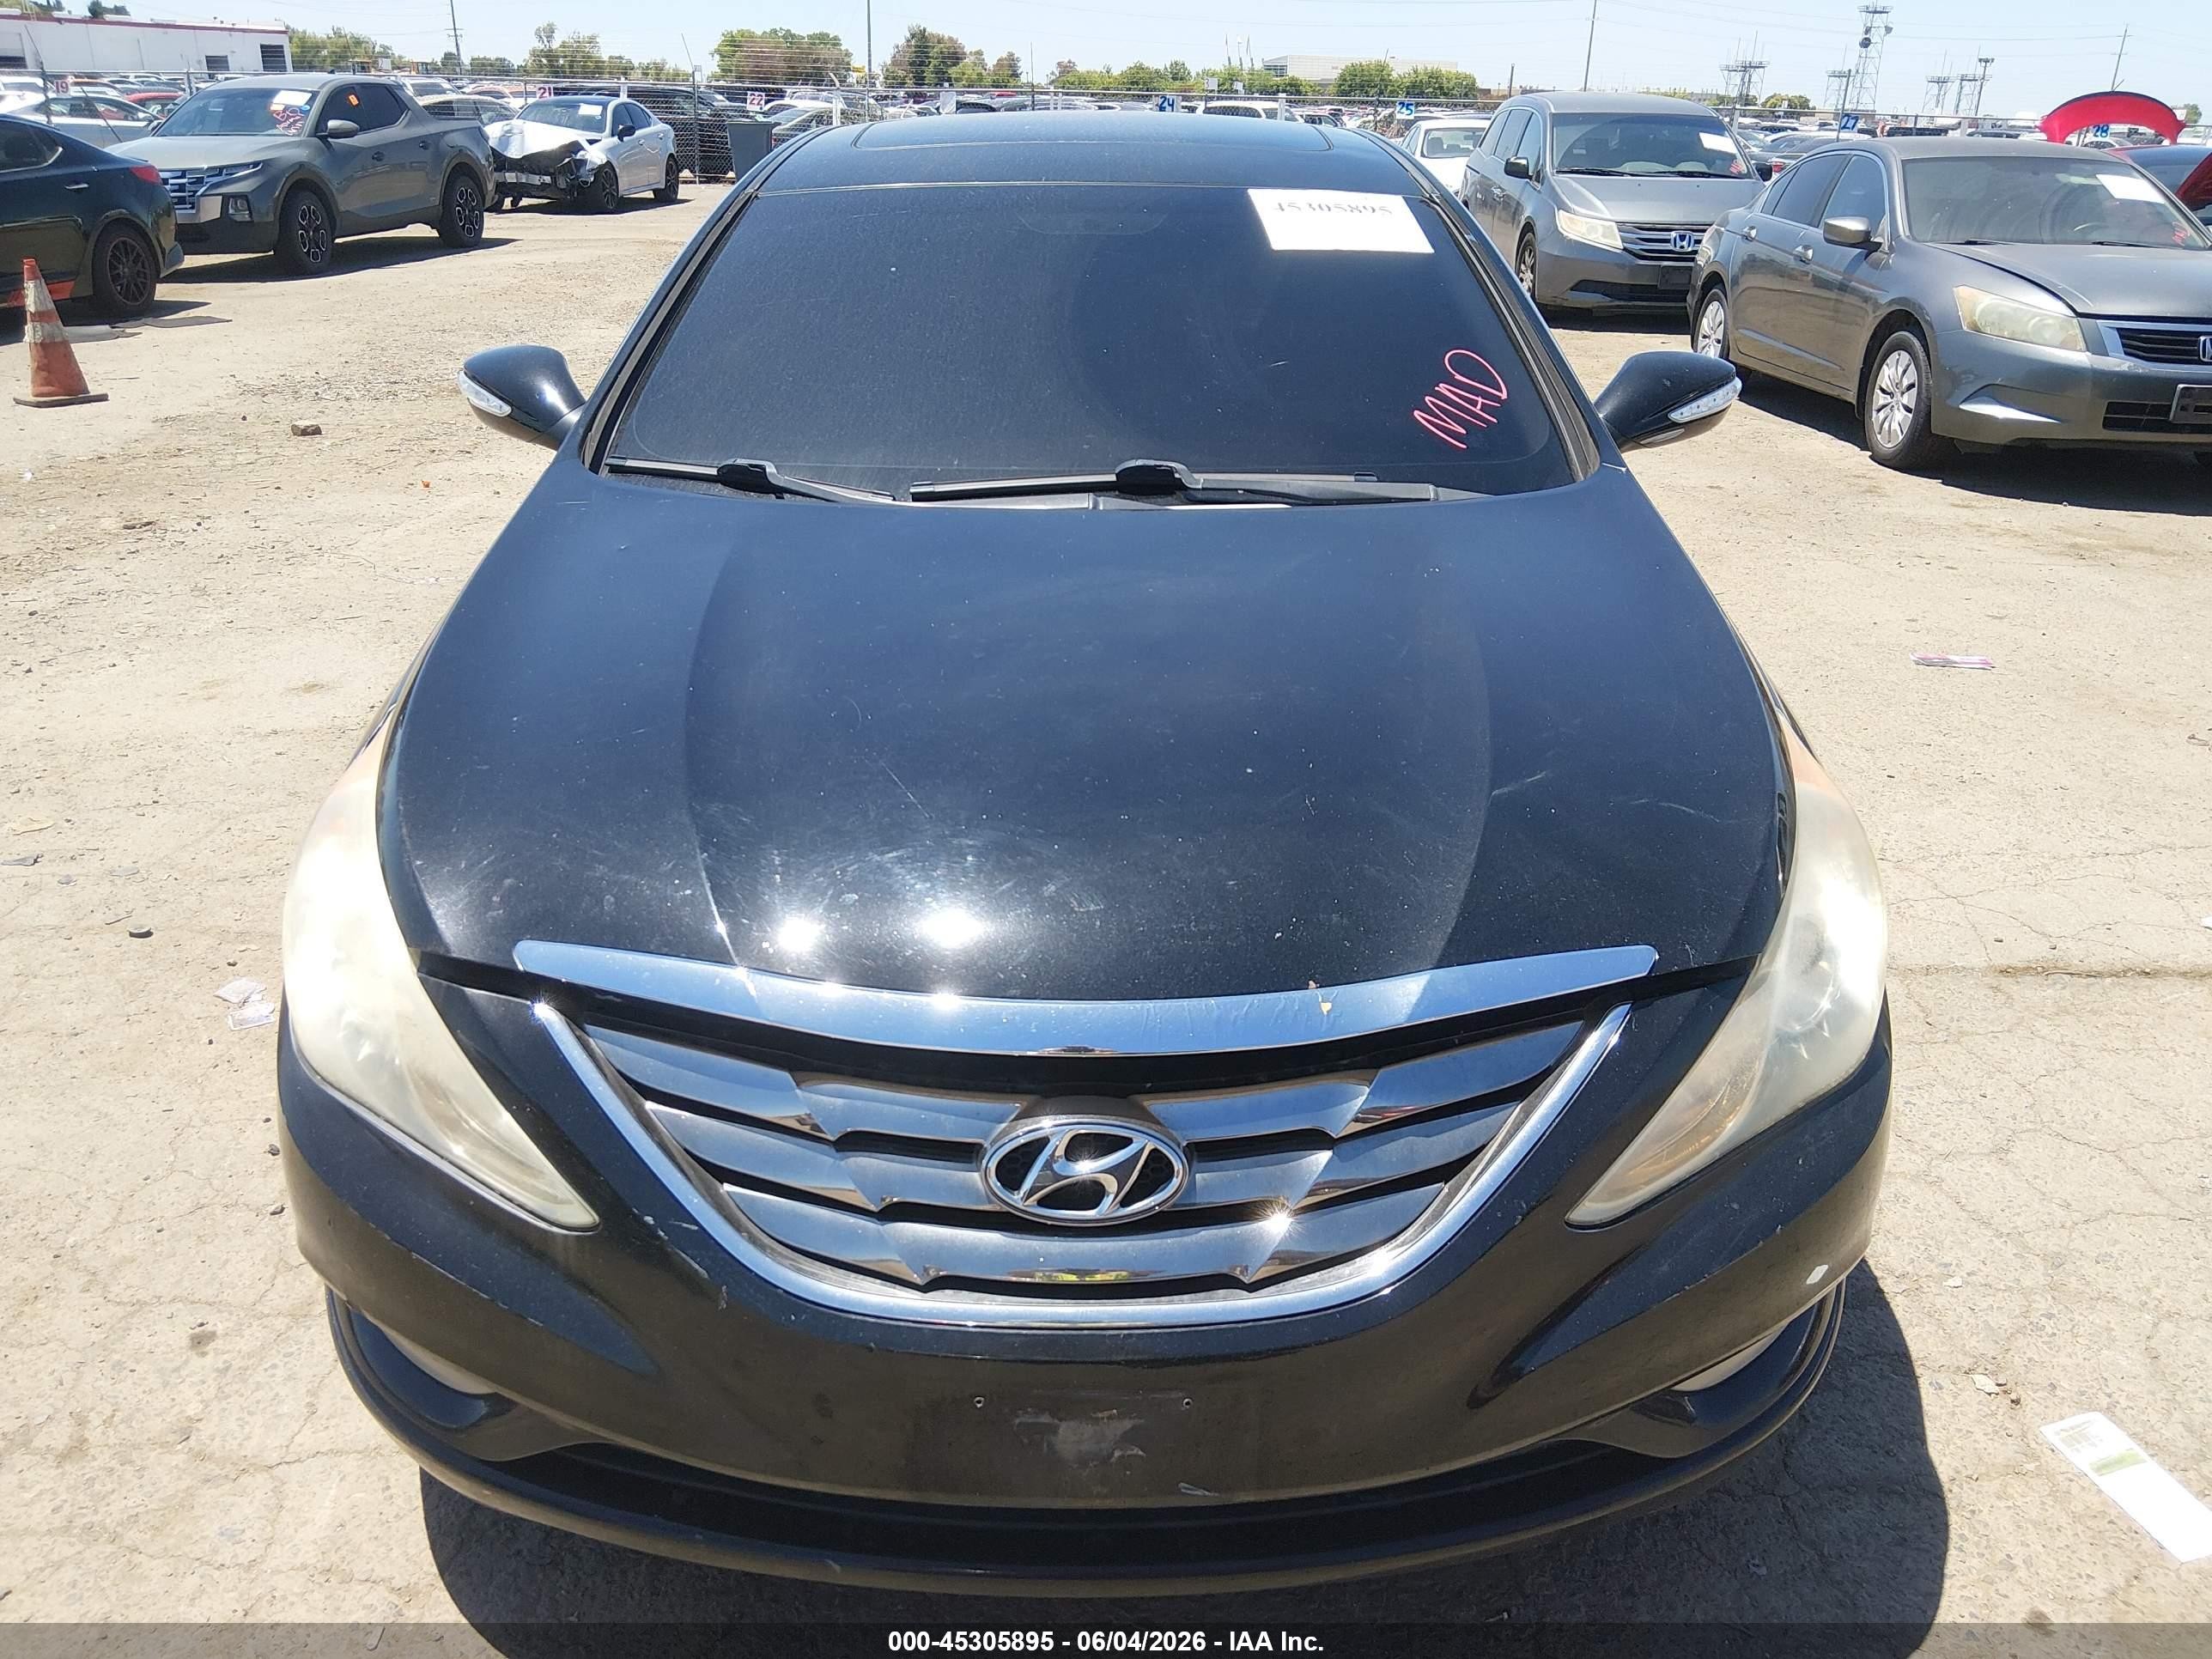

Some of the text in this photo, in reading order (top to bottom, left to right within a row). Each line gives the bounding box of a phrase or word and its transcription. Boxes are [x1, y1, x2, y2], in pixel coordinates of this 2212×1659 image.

[54, 80, 69, 94] 19
[538, 87, 552, 99] 21
[749, 93, 763, 106] 22
[1158, 95, 1175, 112] 24
[1398, 101, 1413, 116] 25
[1841, 113, 1859, 131] 27
[2093, 124, 2110, 138] 28
